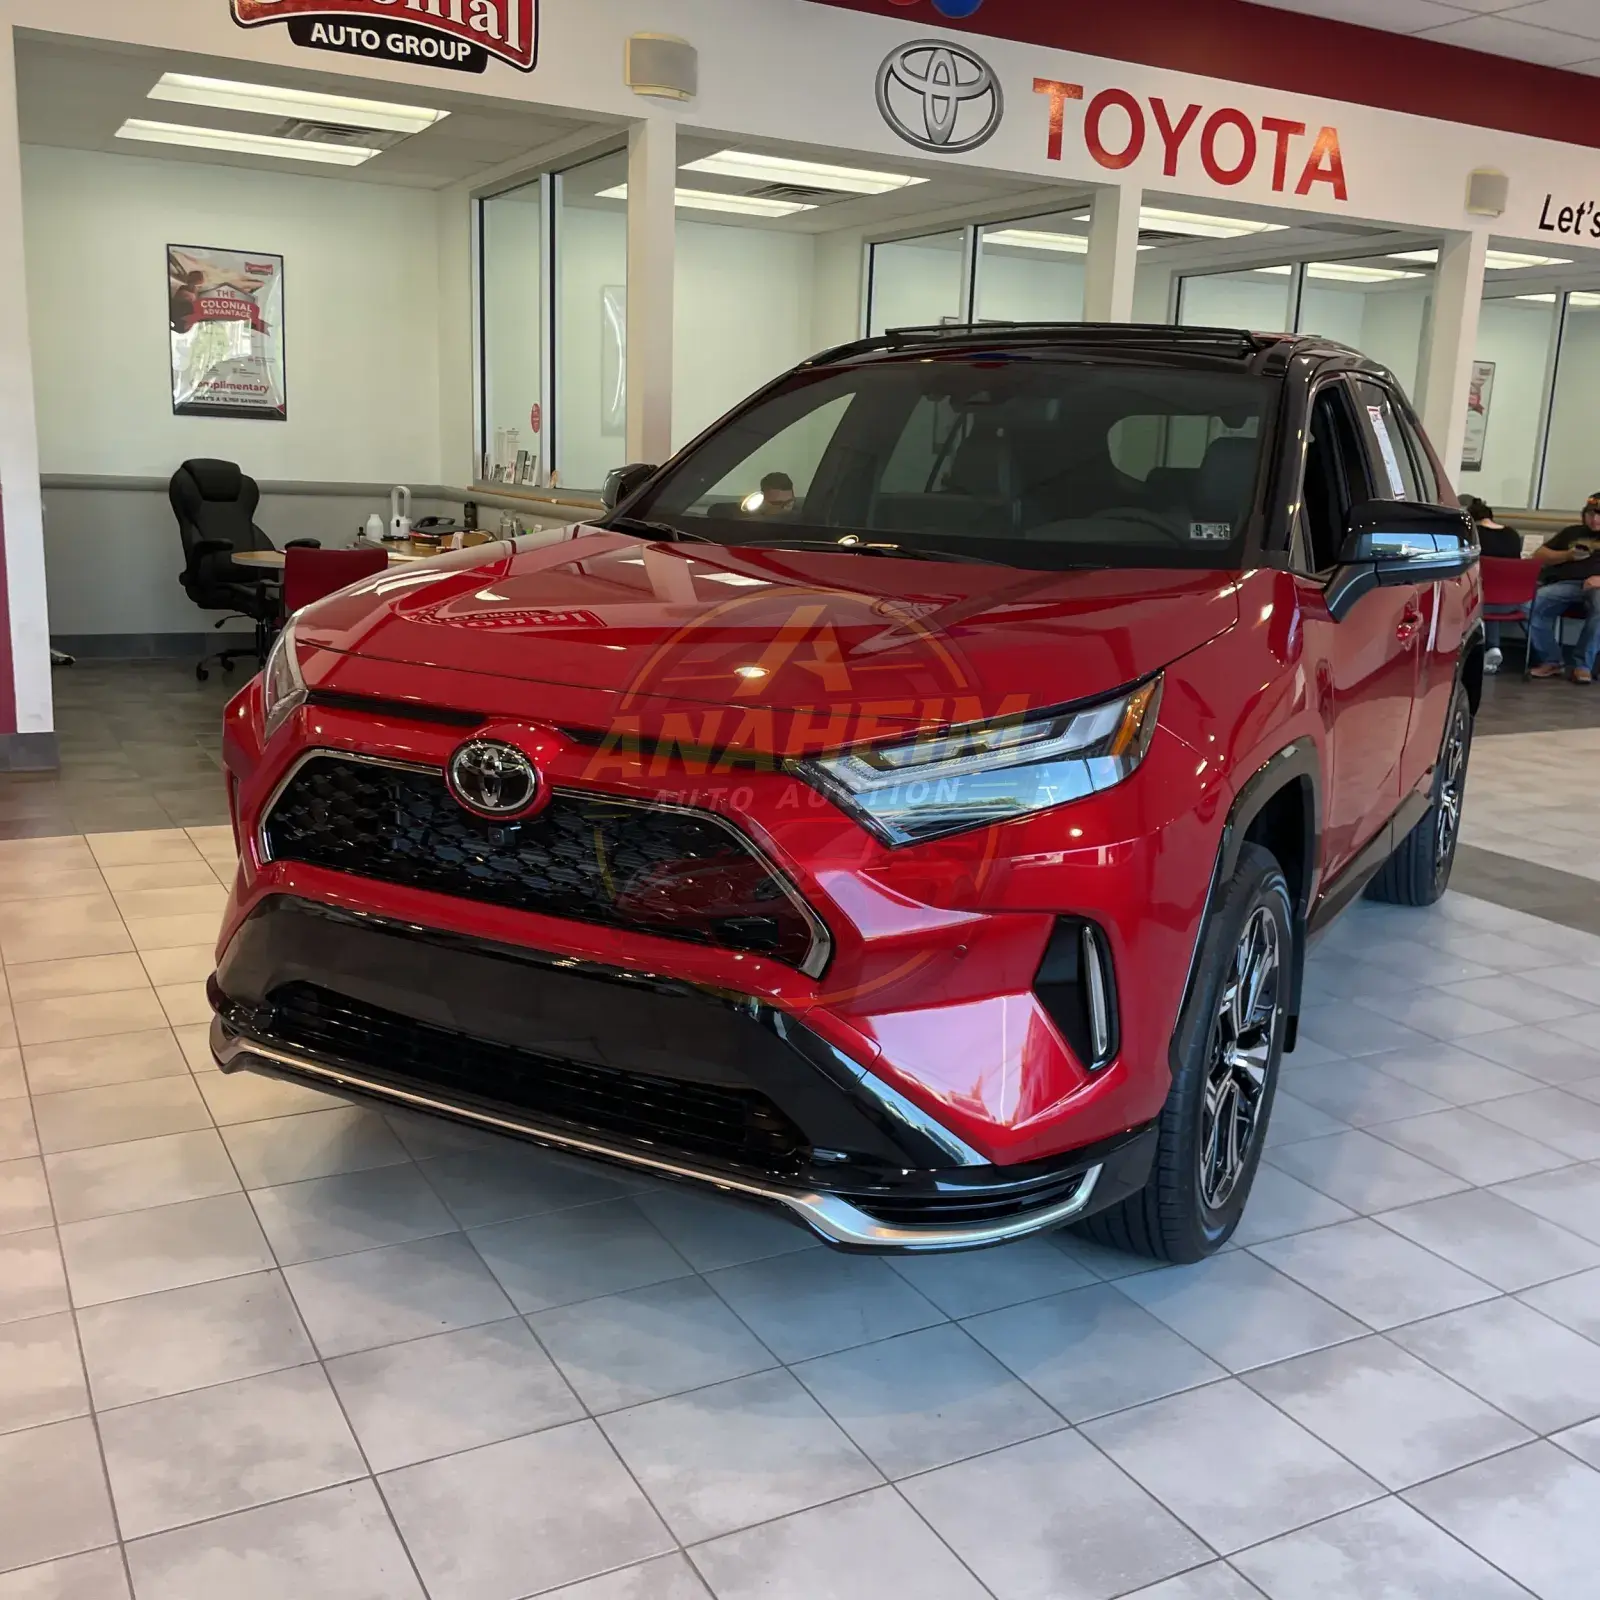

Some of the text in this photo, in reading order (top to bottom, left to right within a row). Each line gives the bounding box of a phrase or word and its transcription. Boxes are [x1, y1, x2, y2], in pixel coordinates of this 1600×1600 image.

[311, 22, 472, 61] AUTO GROUP
[1033, 77, 1348, 201] TOYOTA
[1538, 193, 1600, 238] Let's
[201, 300, 252, 313] COLONIAL
[216, 290, 236, 298] THE
[203, 309, 251, 319] ADVANTAGE
